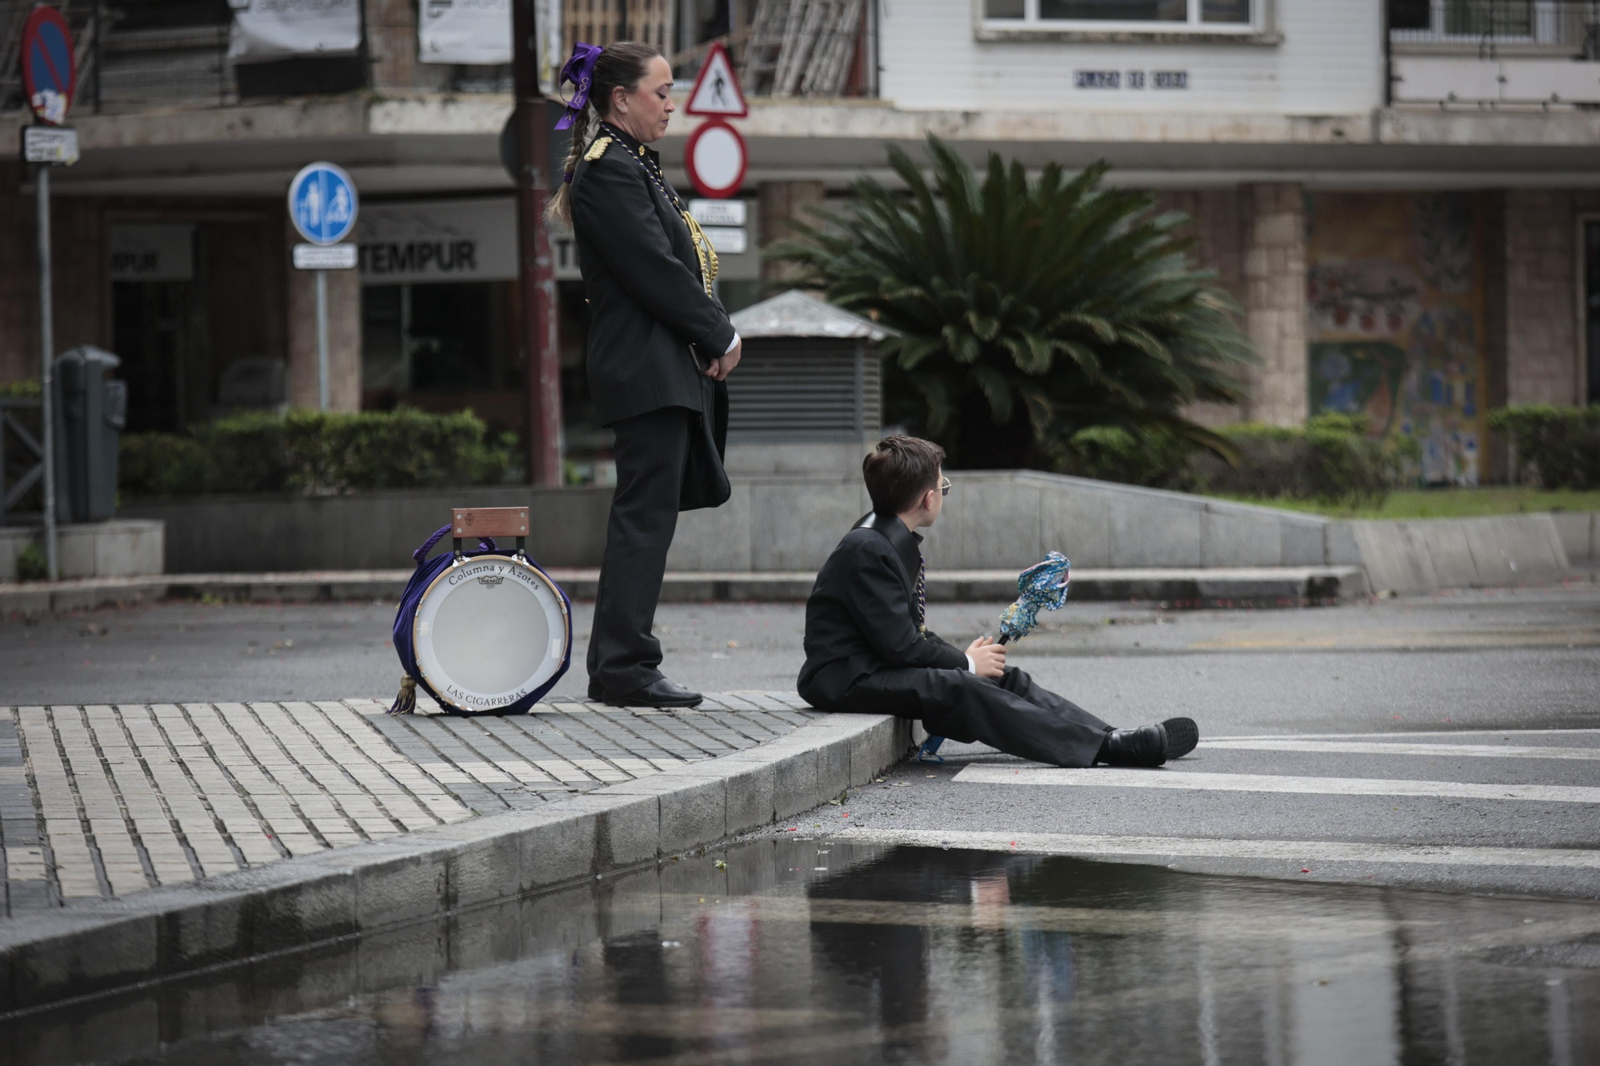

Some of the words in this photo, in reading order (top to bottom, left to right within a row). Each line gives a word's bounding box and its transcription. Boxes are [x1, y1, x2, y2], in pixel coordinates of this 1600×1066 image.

[1073, 70, 1120, 89] PLAZA
[1125, 70, 1144, 89] DE
[1149, 70, 1188, 89] CUBA
[359, 239, 477, 275] TEMPUR
[448, 565, 495, 585] Columna
[498, 566, 504, 574] y
[507, 566, 540, 591] Azotes
[446, 684, 464, 700] LAS
[465, 688, 527, 706] CIGARRERAS
